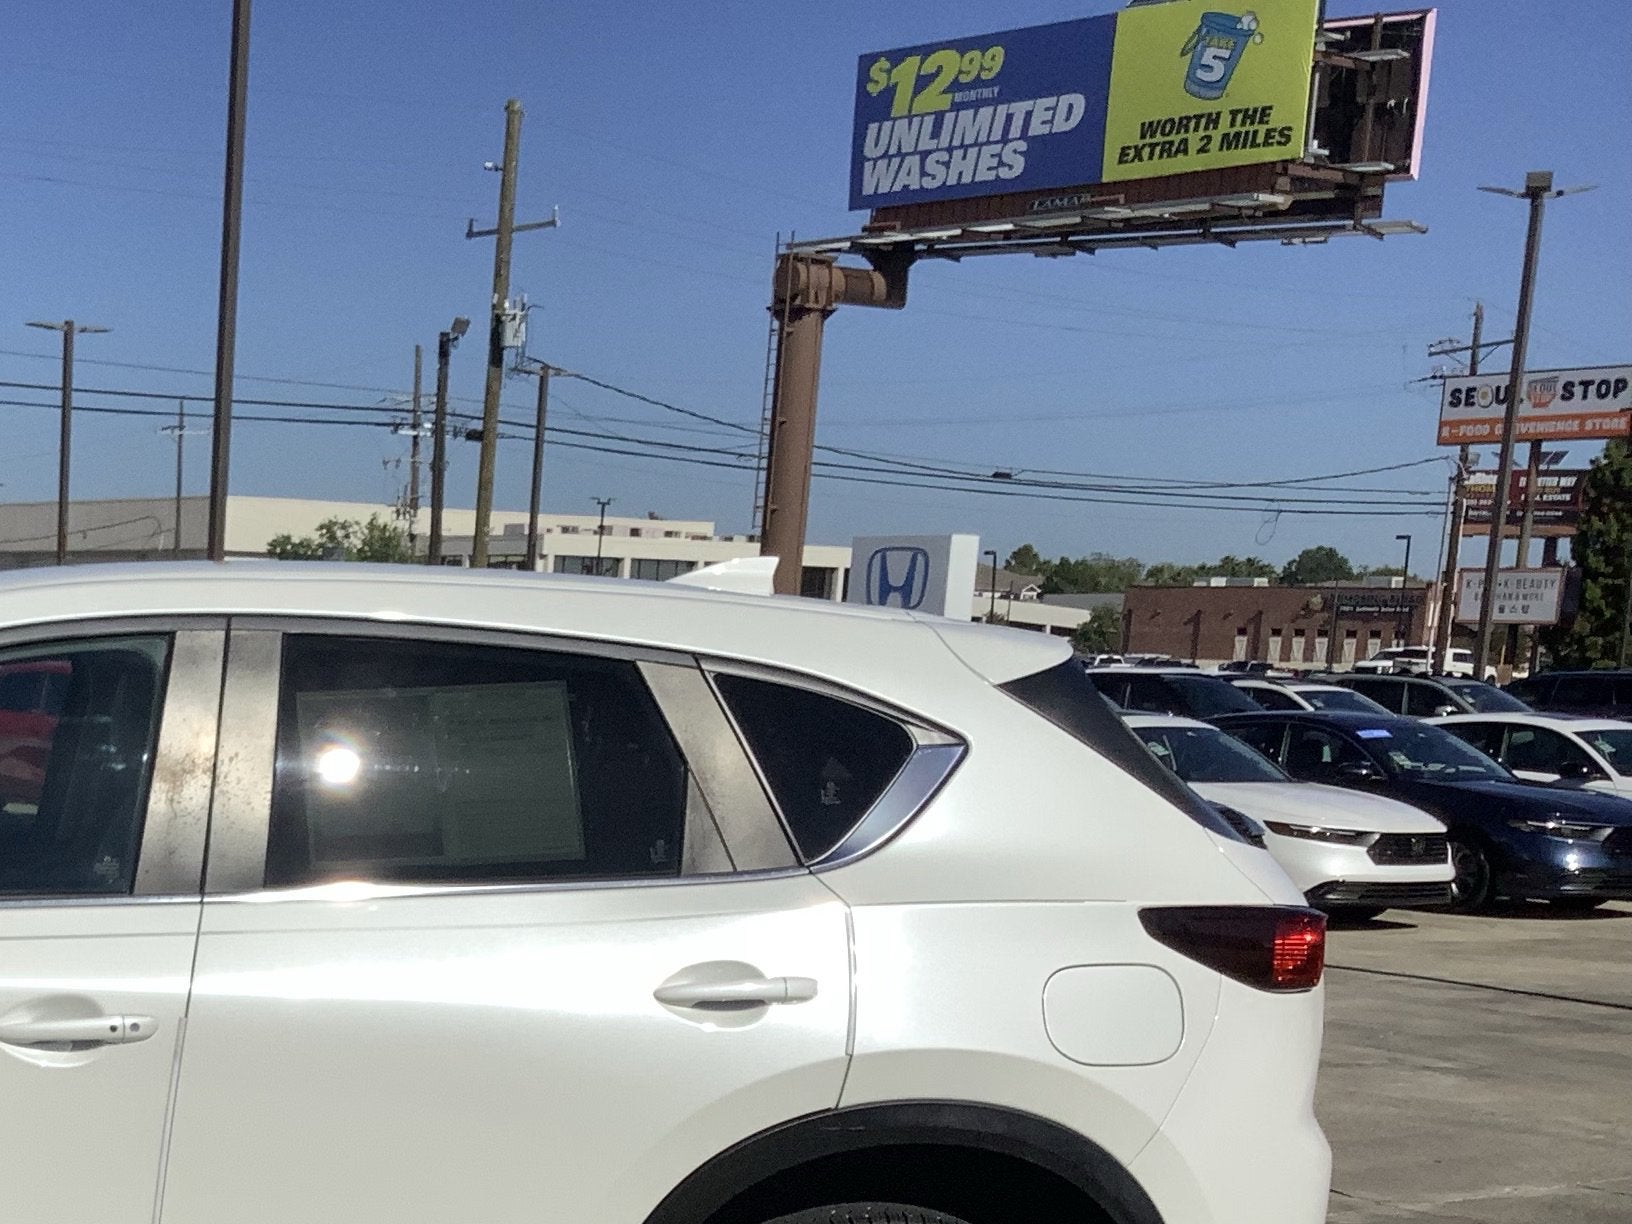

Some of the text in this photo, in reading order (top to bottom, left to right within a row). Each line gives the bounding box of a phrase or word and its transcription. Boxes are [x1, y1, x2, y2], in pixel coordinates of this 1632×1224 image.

[1195, 47, 1231, 83] 5
[863, 93, 1086, 159] UNLIMITED
[1139, 105, 1273, 140] WORTH THE
[1118, 126, 1293, 165] EXTRA 2 MILES
[862, 140, 1028, 195] WASHES
[1560, 377, 1629, 401] STOP
